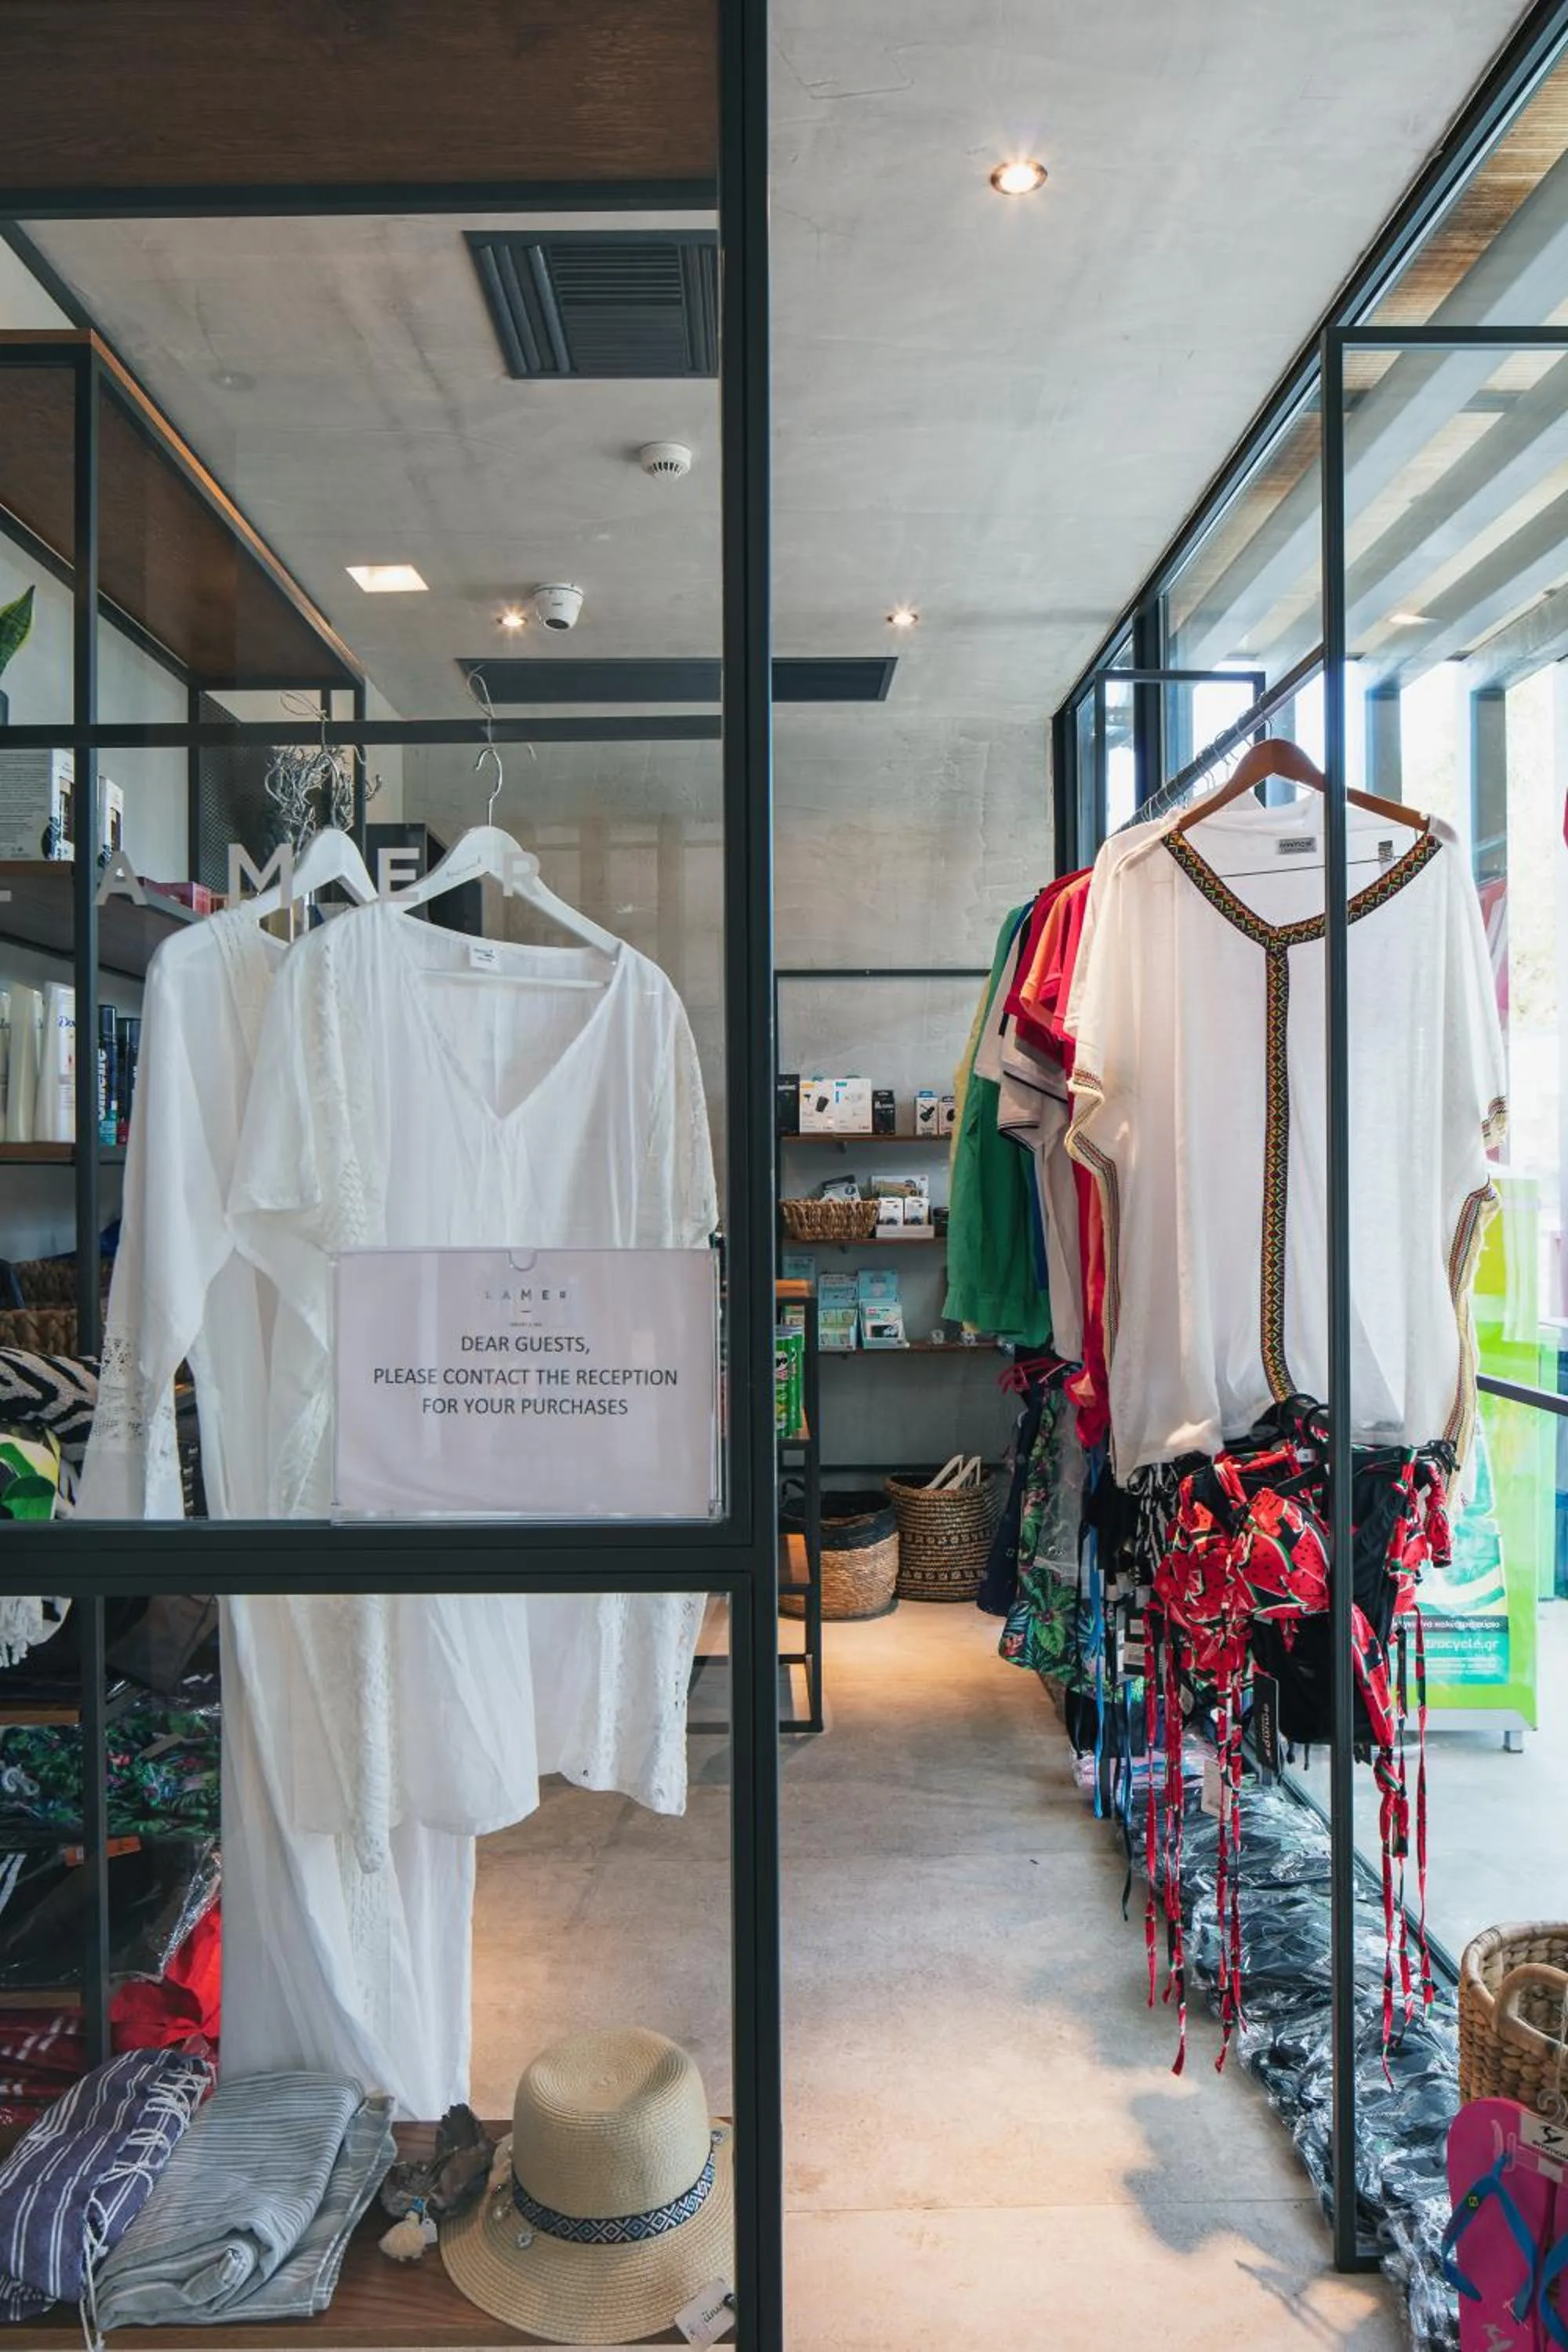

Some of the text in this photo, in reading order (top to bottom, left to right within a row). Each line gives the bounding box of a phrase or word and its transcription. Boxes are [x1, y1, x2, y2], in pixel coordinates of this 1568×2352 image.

[0, 844, 541, 908] AMER
[461, 1335, 590, 1356] DEAR GUESTS,
[373, 1367, 678, 1386] PLEASE CONTACT THE RECEPTION
[423, 1398, 628, 1416] FOR YOUR PURCHASES
